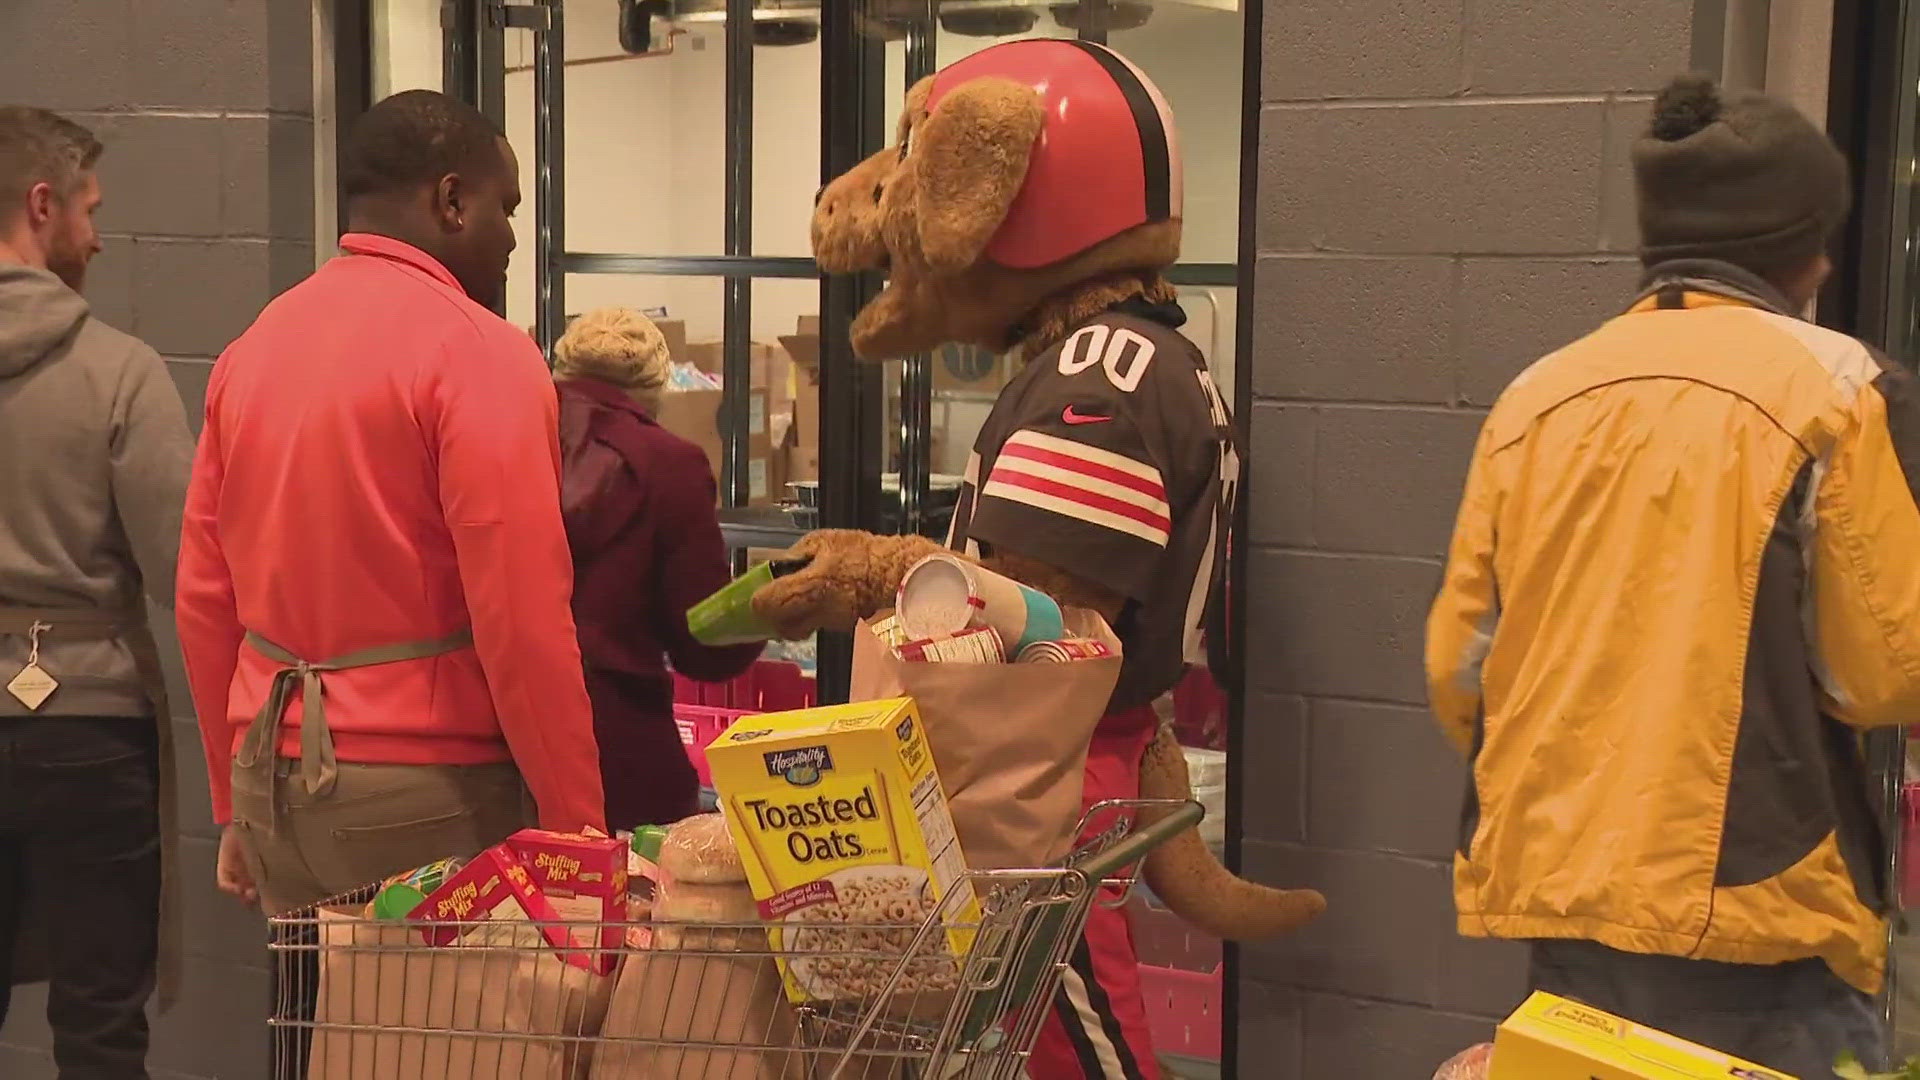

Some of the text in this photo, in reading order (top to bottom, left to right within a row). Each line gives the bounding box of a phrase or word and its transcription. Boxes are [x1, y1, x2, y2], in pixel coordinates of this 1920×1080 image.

[1058, 325, 1155, 392] 00
[770, 747, 826, 772] Hospitality
[744, 785, 878, 831] Toasted
[787, 830, 864, 864] Oats
[535, 852, 581, 876] Stuffing
[546, 866, 569, 881] Mix
[437, 881, 477, 918] Stuffing
[453, 898, 474, 920] Mix
